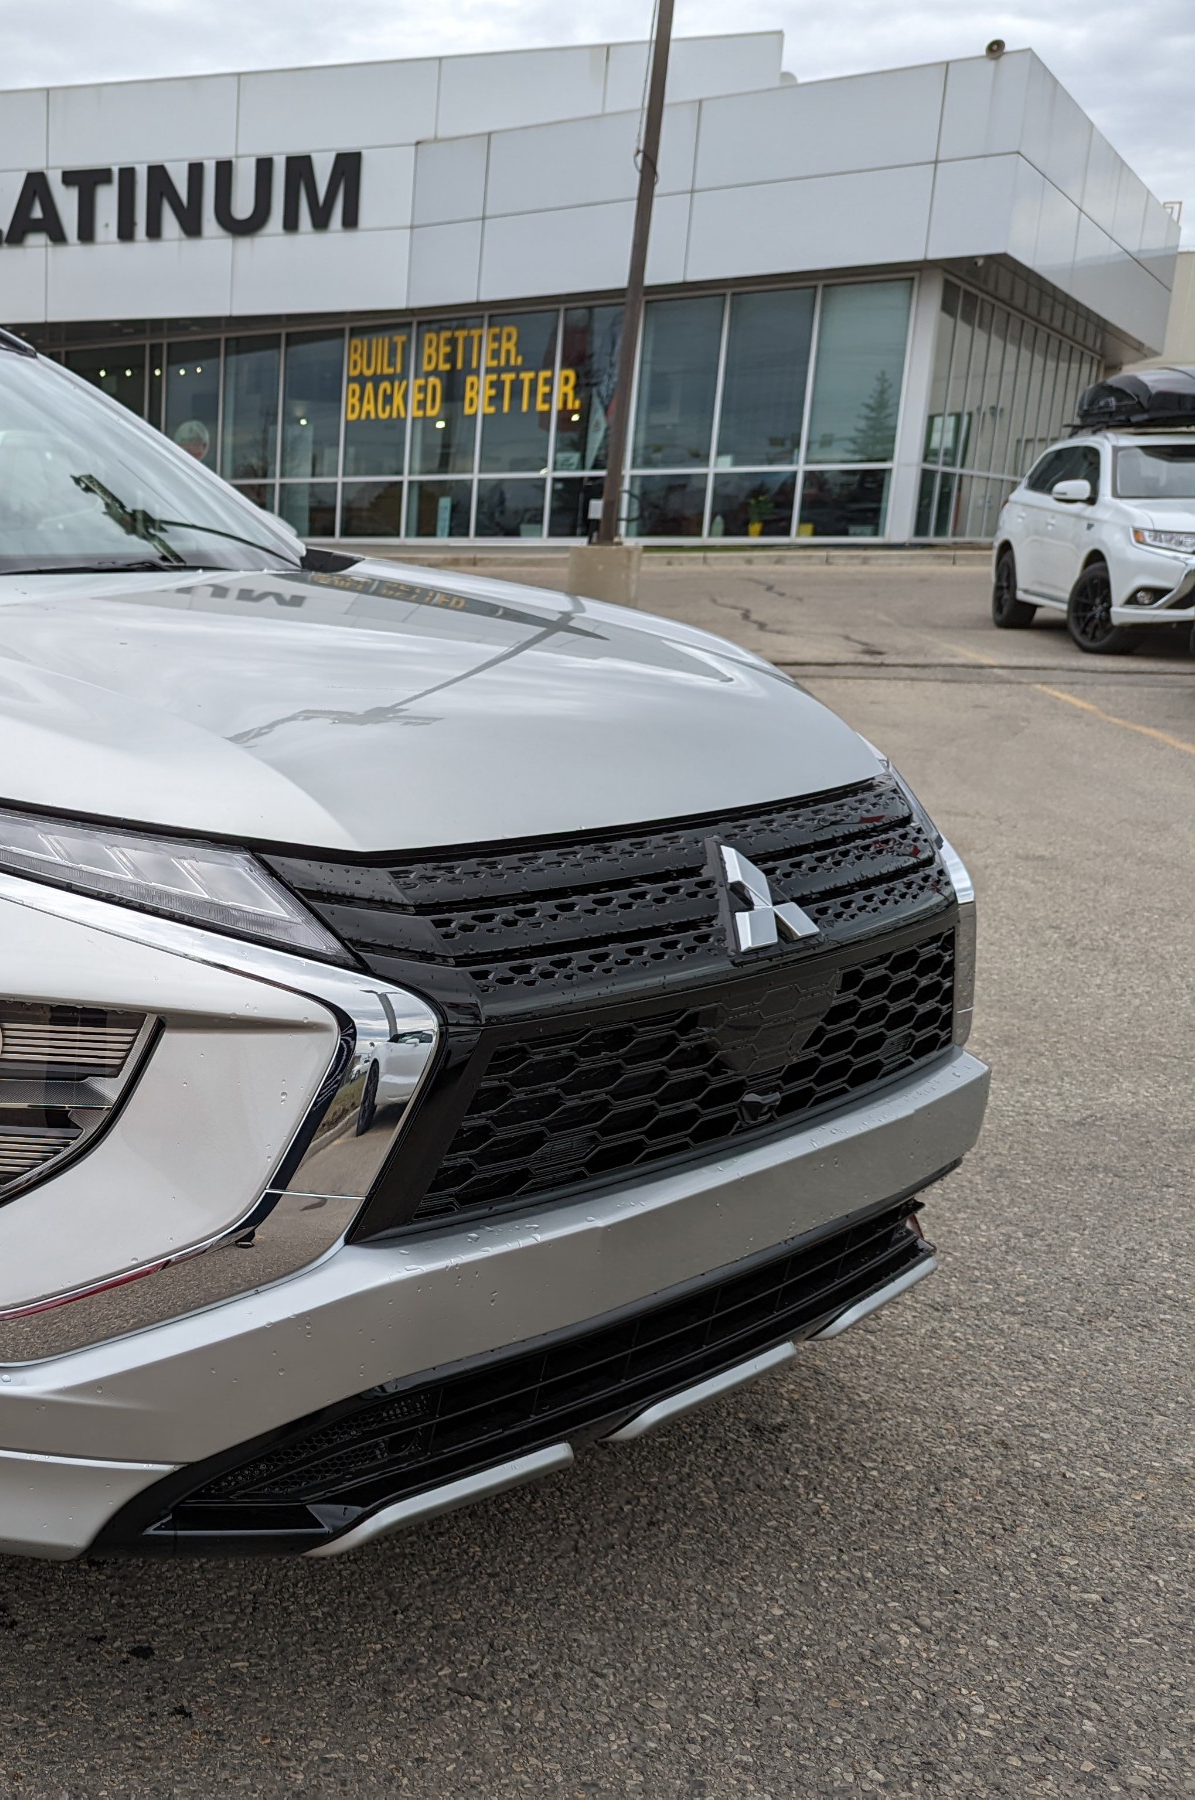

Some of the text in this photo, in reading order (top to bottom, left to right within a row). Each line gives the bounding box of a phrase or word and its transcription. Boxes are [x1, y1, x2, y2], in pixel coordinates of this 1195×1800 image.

[348, 325, 523, 377] BUILT BETTER.
[346, 369, 581, 421] BACKED BETTER.
